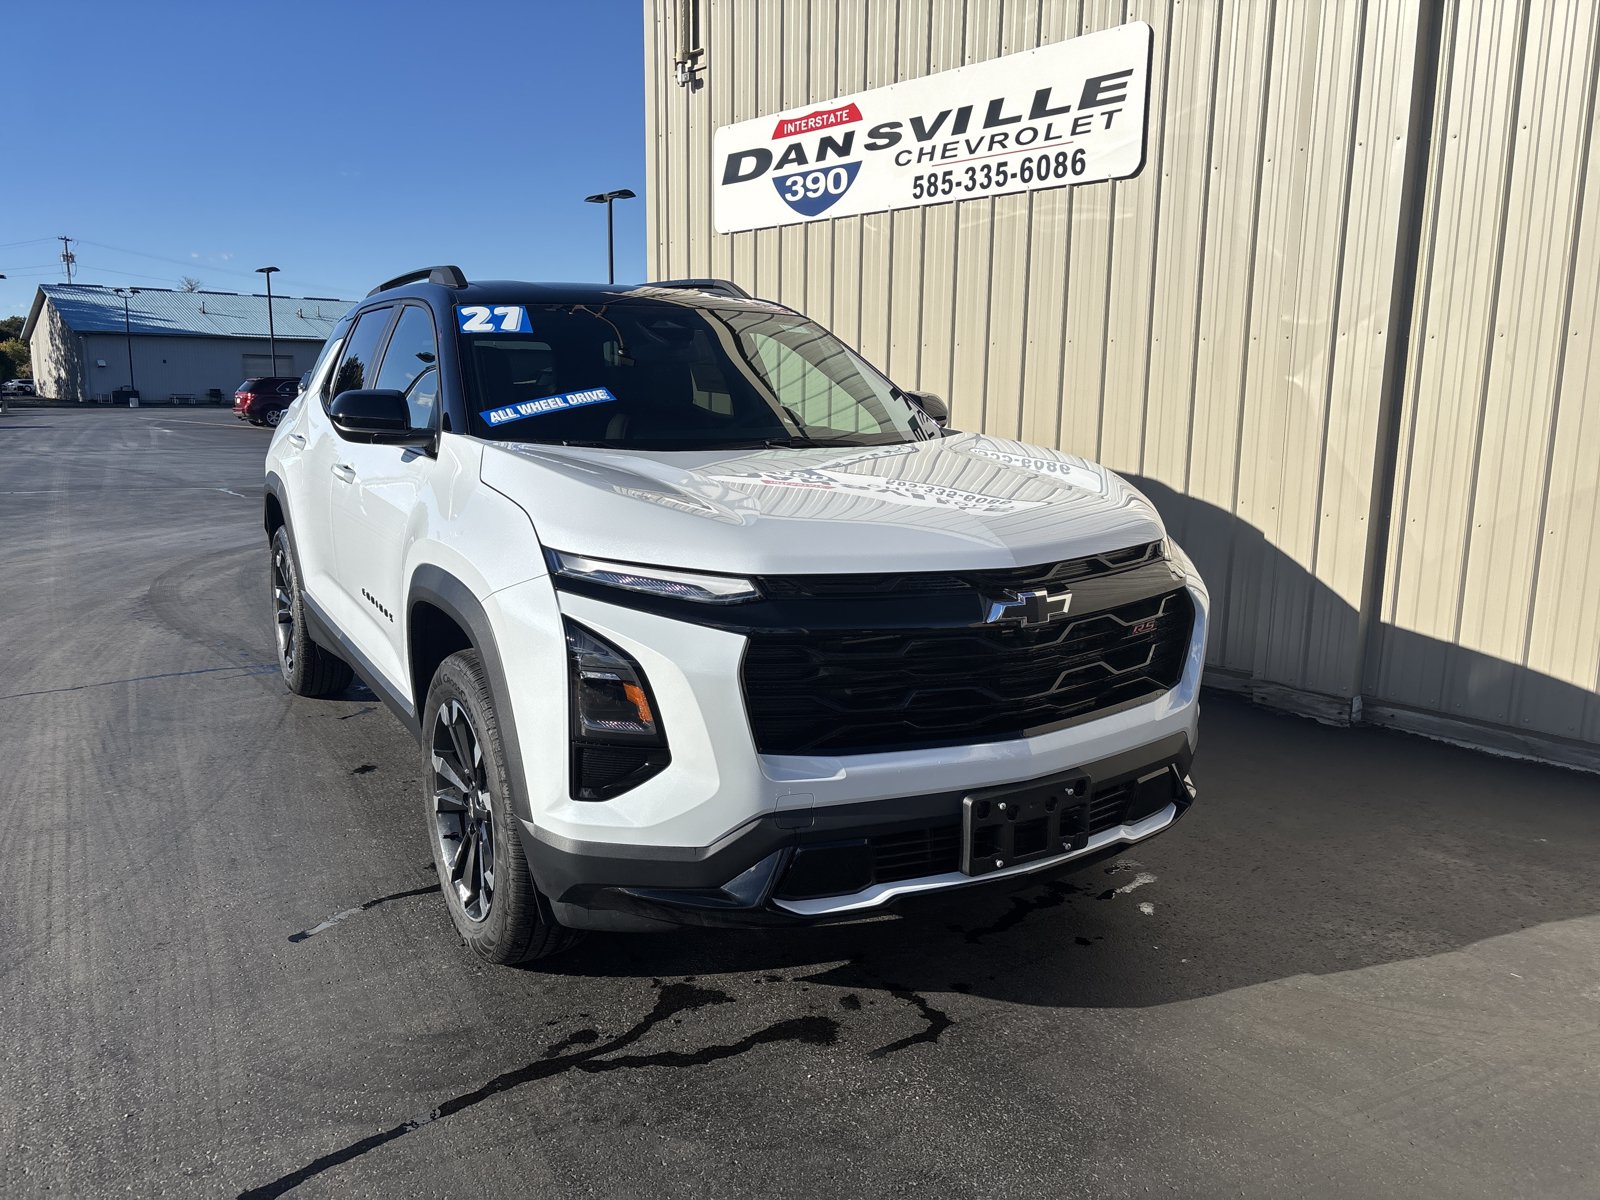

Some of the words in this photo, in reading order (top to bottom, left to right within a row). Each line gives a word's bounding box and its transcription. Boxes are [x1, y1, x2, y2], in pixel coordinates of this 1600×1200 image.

[722, 68, 1134, 186] DANSVILLE
[783, 109, 850, 135] INTERSTATE
[894, 108, 1123, 167] CHEVROLET
[784, 167, 849, 202] 390
[912, 148, 1087, 200] 585-335-6086
[460, 306, 523, 332] 27
[489, 408, 520, 424] ALL
[516, 396, 568, 416] WHEEL
[566, 389, 610, 406] DRIVE
[1132, 619, 1156, 636] RS
